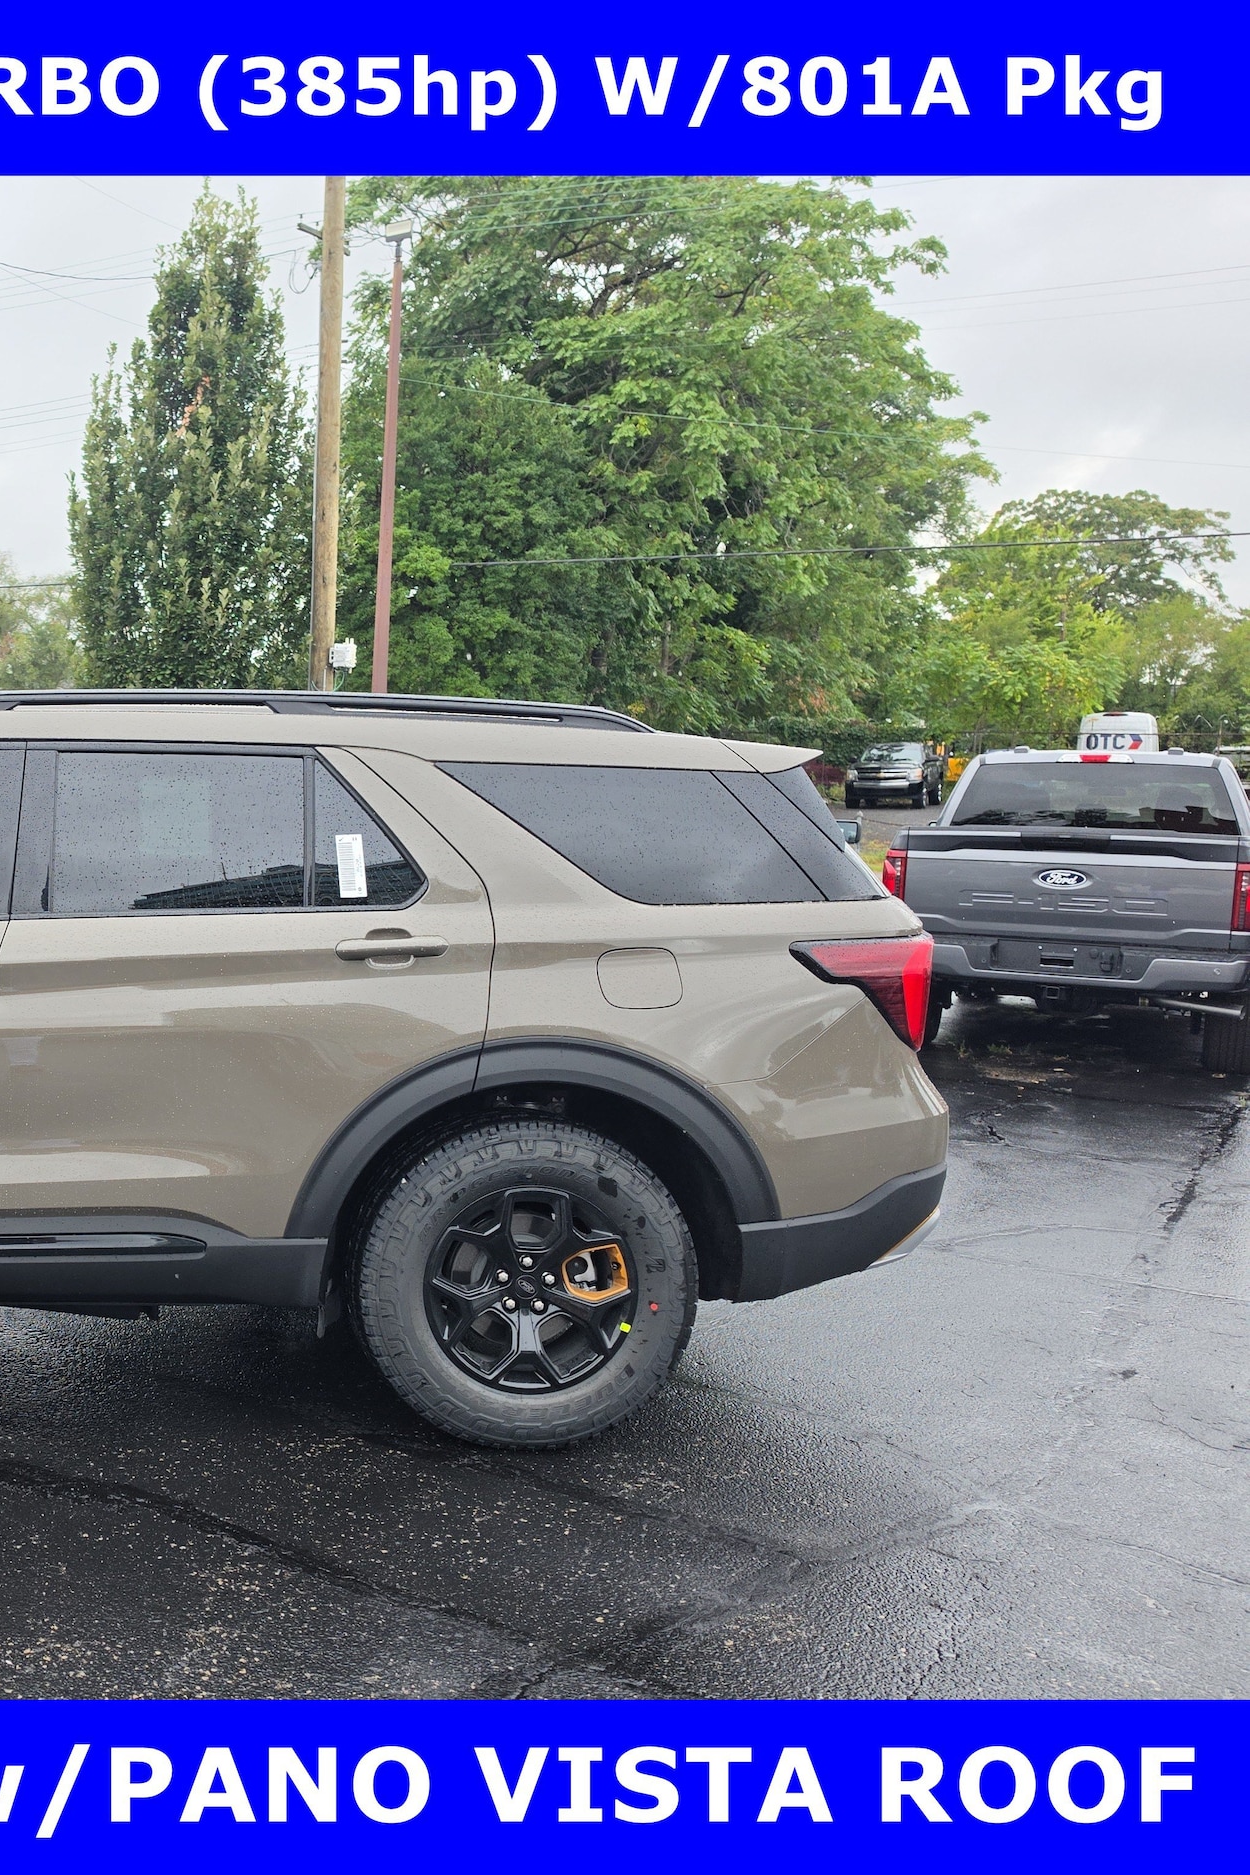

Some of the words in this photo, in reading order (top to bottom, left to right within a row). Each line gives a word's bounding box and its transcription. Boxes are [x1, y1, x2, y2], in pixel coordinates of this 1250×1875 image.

[1086, 733, 1125, 750] OTC
[1046, 872, 1078, 885] Ford
[958, 889, 1168, 917] F-150
